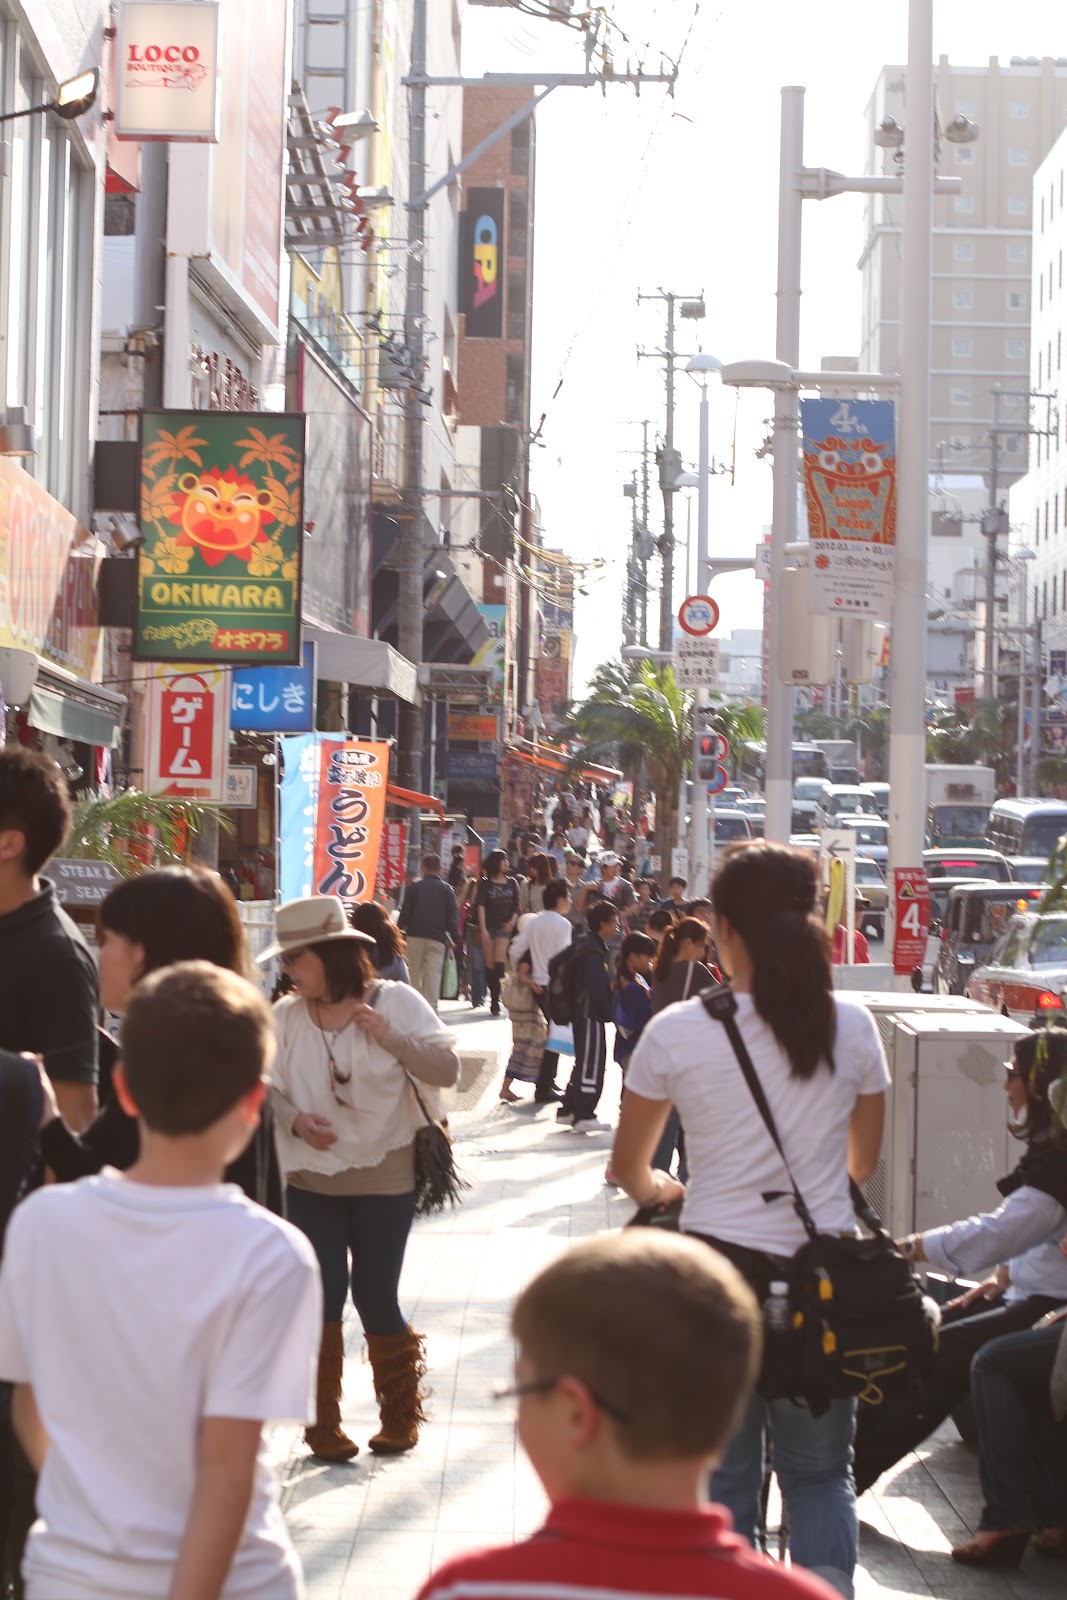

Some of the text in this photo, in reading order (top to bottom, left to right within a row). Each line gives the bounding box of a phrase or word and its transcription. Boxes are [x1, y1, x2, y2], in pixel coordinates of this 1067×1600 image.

[128, 44, 200, 63] LOCO
[472, 215, 498, 309] OPA
[834, 496, 873, 512] Laugh
[835, 515, 874, 530] Peace
[150, 581, 285, 609] OKIWARA
[216, 631, 284, 651] オキワラ
[231, 681, 306, 714] にしき
[168, 695, 204, 776] ゲーム
[60, 864, 115, 881] STEAK &
